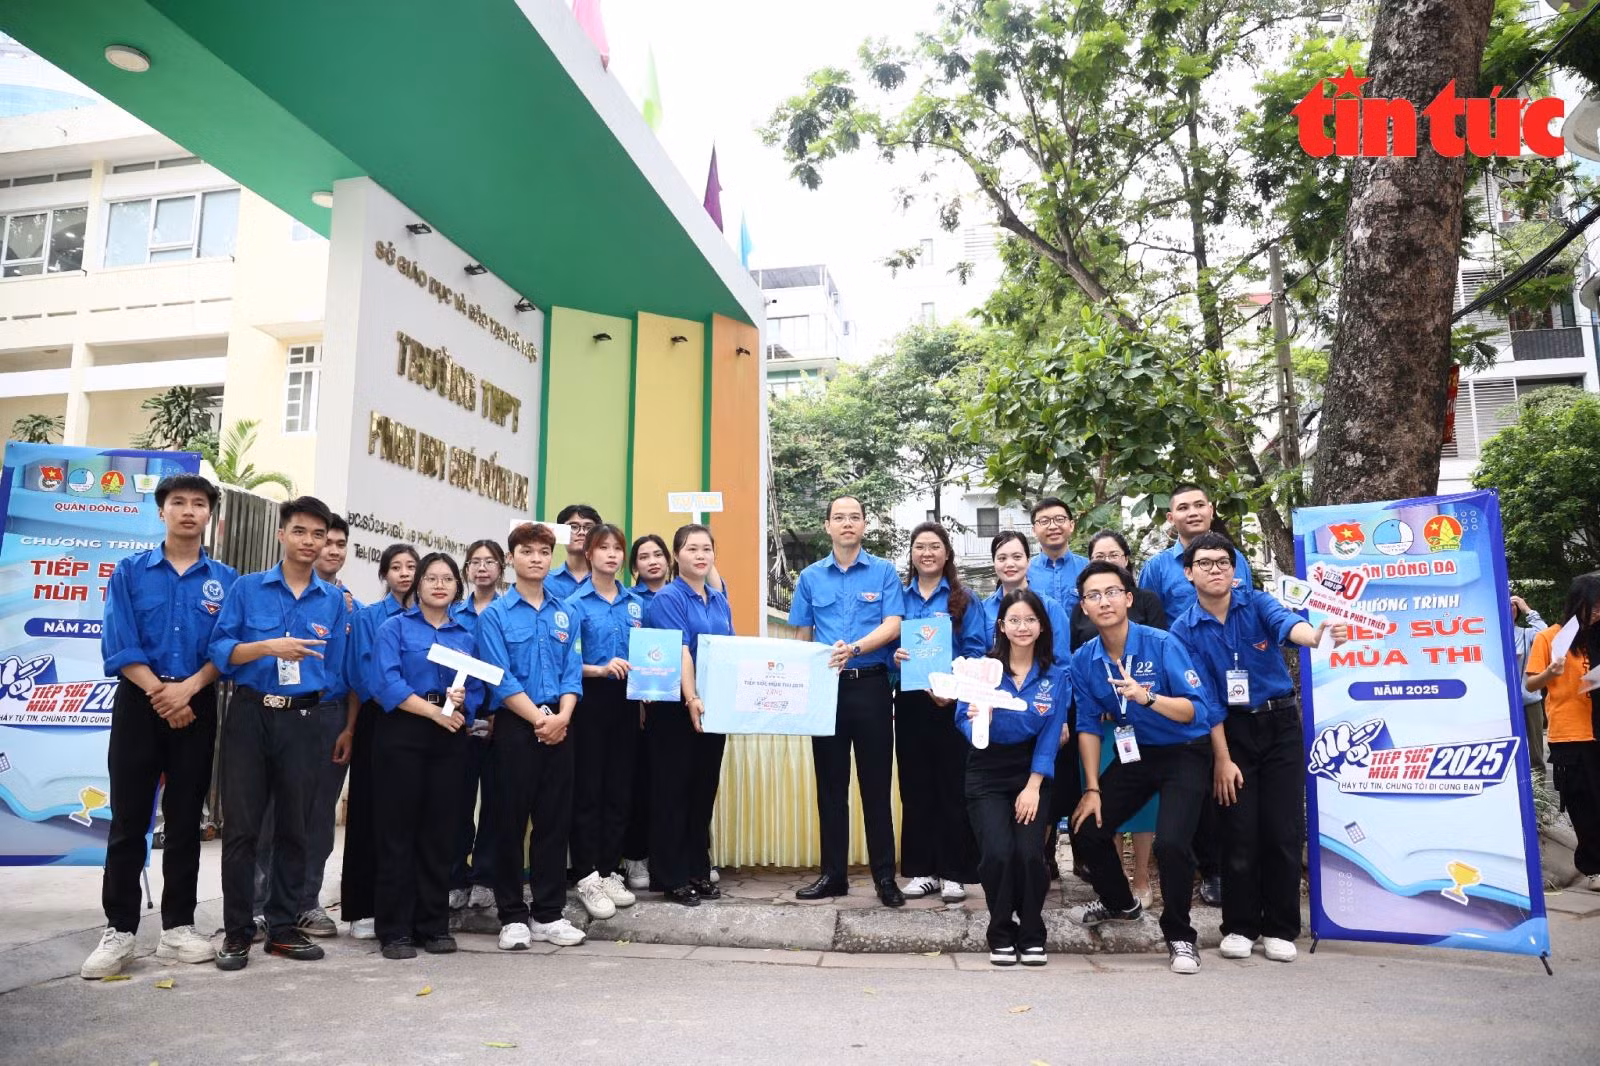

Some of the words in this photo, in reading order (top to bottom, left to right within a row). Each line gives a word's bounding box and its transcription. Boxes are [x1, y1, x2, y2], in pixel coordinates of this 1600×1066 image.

[375, 240, 396, 266] SỞ
[397, 255, 428, 288] GIÁO
[396, 330, 477, 412] TRƯỜNG
[480, 378, 522, 433] THPT
[123, 505, 139, 514] ĐA
[20, 535, 102, 549] CHƯƠNG
[31, 556, 89, 577] TIẾP
[1386, 559, 1428, 577] ĐỐNG
[1433, 560, 1456, 574] ĐA
[33, 582, 88, 601] MÙA
[1341, 570, 1365, 601] 10
[1412, 593, 1460, 610] TRÌNH
[43, 619, 80, 633] NĂM
[1411, 612, 1485, 638] SỨC
[1330, 645, 1409, 668] MÙA
[1422, 646, 1483, 665] THI
[1135, 661, 1153, 673] 22
[1406, 684, 1440, 696] 2025
[59, 699, 84, 712] THI
[1429, 741, 1508, 776] 2025
[1402, 765, 1428, 779] THI
